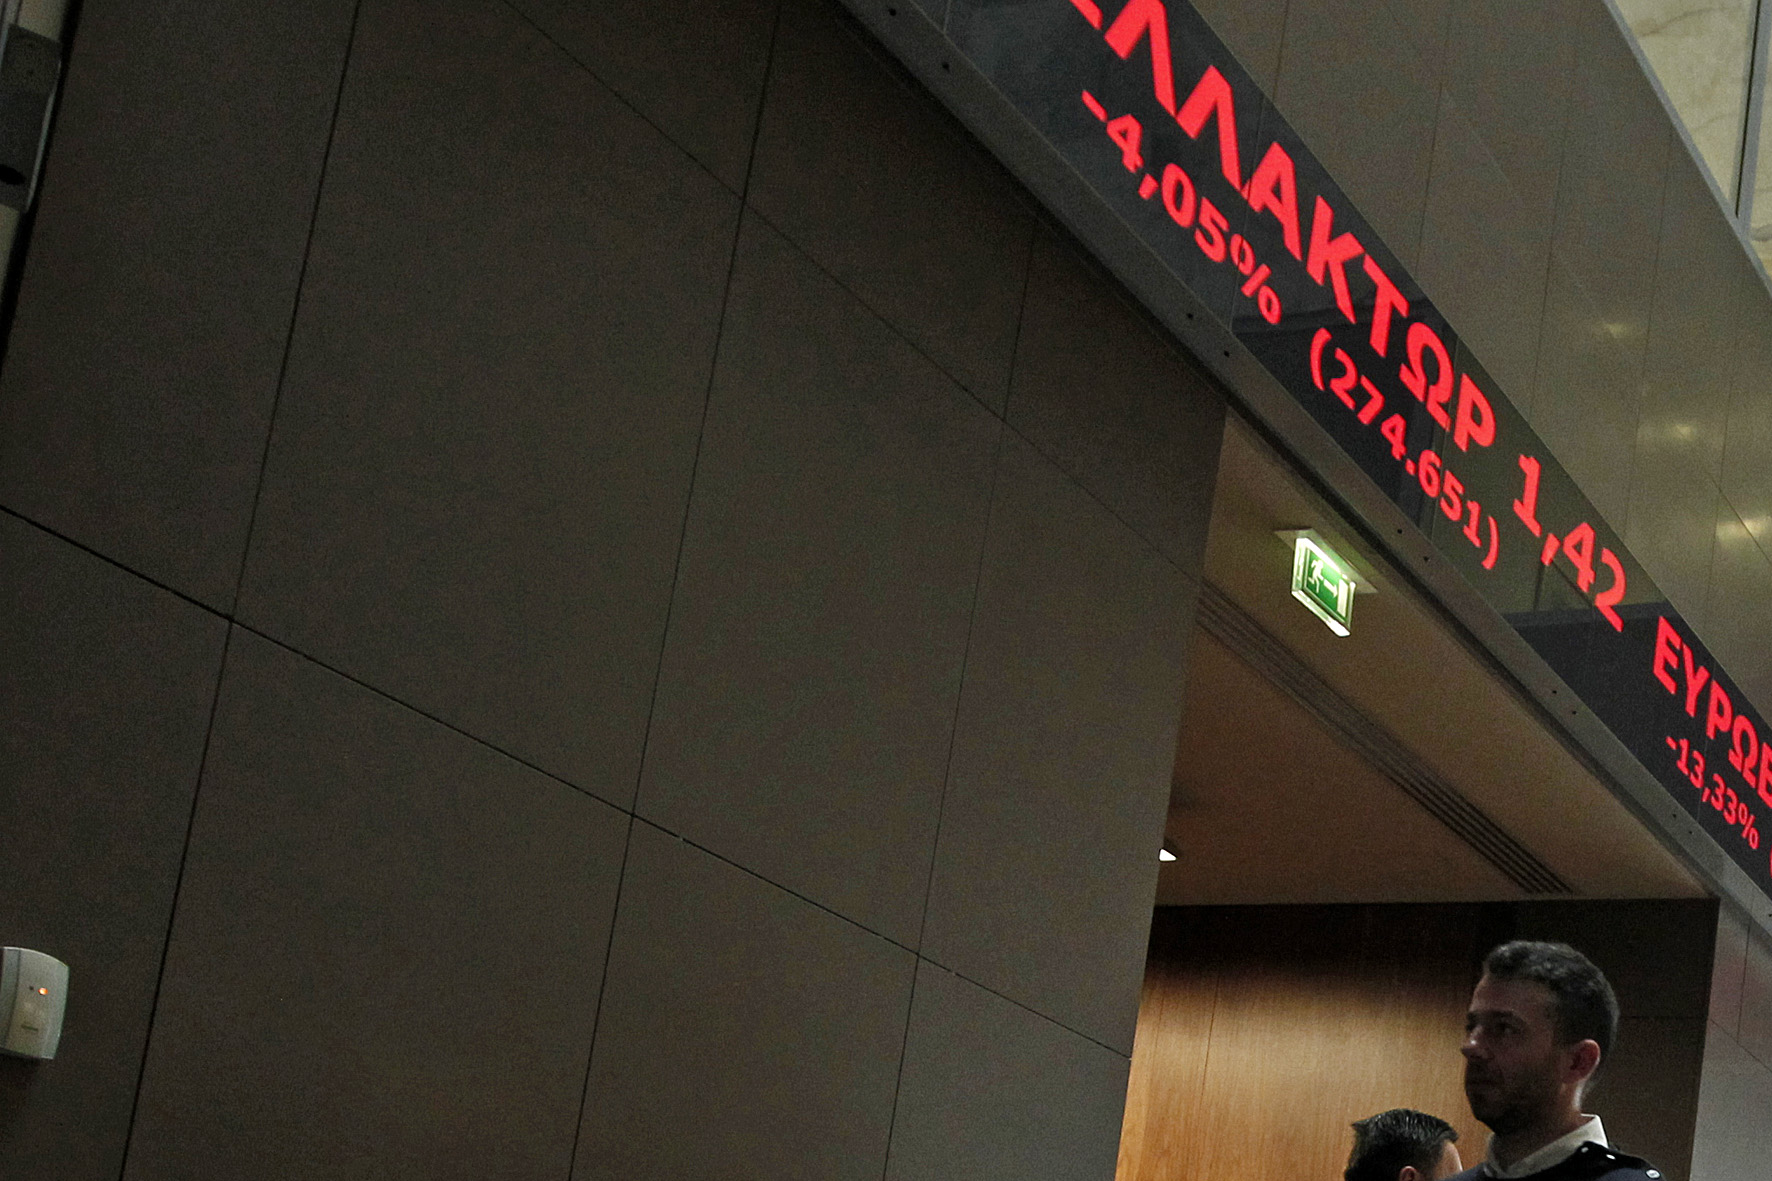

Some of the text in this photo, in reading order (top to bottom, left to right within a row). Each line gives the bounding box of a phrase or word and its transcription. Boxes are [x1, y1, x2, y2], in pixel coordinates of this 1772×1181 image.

[1070, 0, 1627, 632] ΛΛΑΚΤΩΡ 1,42
[1081, 90, 1500, 570] -4,05% (274.651)
[1665, 736, 1759, 850] -13,33%
